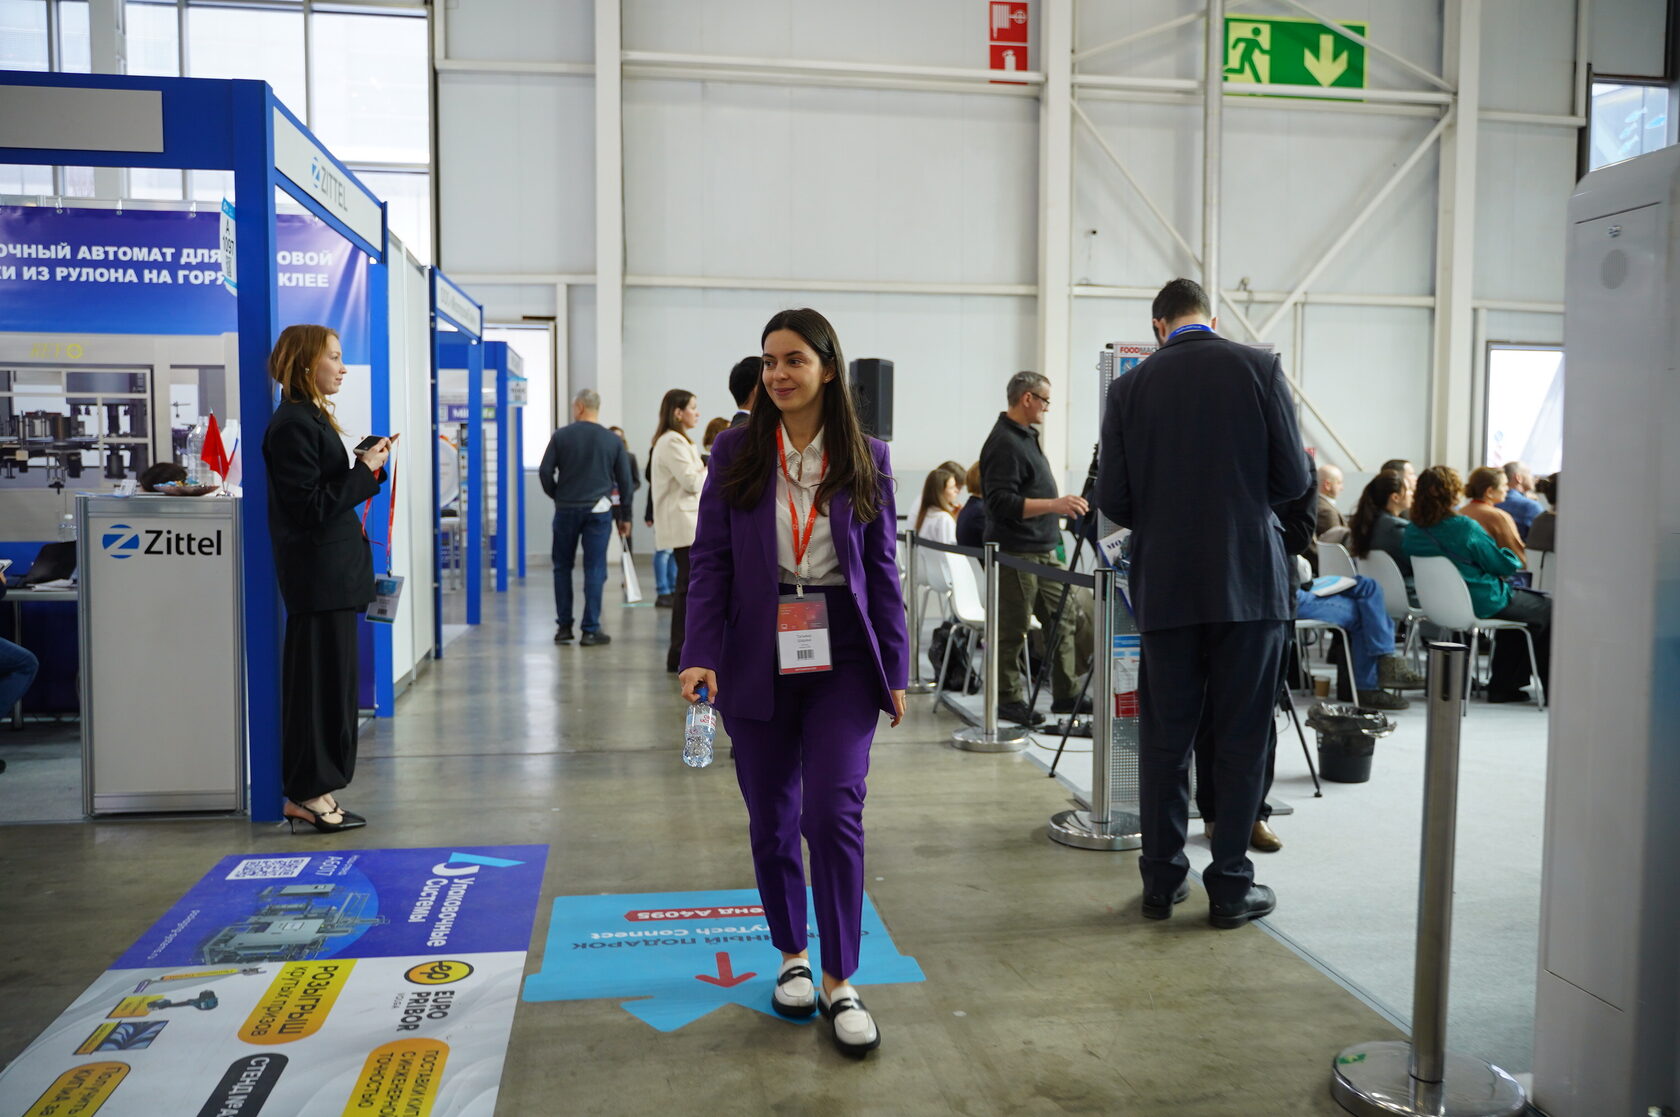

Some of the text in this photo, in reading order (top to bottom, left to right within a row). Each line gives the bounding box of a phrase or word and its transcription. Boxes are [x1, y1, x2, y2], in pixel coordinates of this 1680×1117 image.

[321, 165, 348, 213] ZITTEL
[77, 245, 175, 262] АВТОМАТ
[181, 248, 222, 265] ДЛЯ
[276, 249, 333, 267] ОВОЙ
[23, 266, 50, 281] ИЗ
[56, 267, 138, 283] РУЛОНА
[143, 269, 172, 284] НА
[177, 270, 225, 286] ГОРЯ
[278, 272, 329, 288] КЛЕЕ
[144, 529, 222, 556] Zittel
[407, 878, 449, 923] Системы
[426, 877, 475, 947] Упаковочные
[637, 907, 765, 920] енд А4095
[572, 938, 697, 950] ПОДАРОК
[590, 929, 689, 940] Connect
[277, 965, 339, 1035] РОЗЫГРЫШ
[396, 991, 432, 1032] PRIBOR
[426, 990, 456, 1020] EURO
[228, 1056, 270, 1095] СТЕНД
[358, 1052, 394, 1108] ТОЧНОСТЬЮ
[409, 1050, 439, 1096] ПОСТАВКИ
